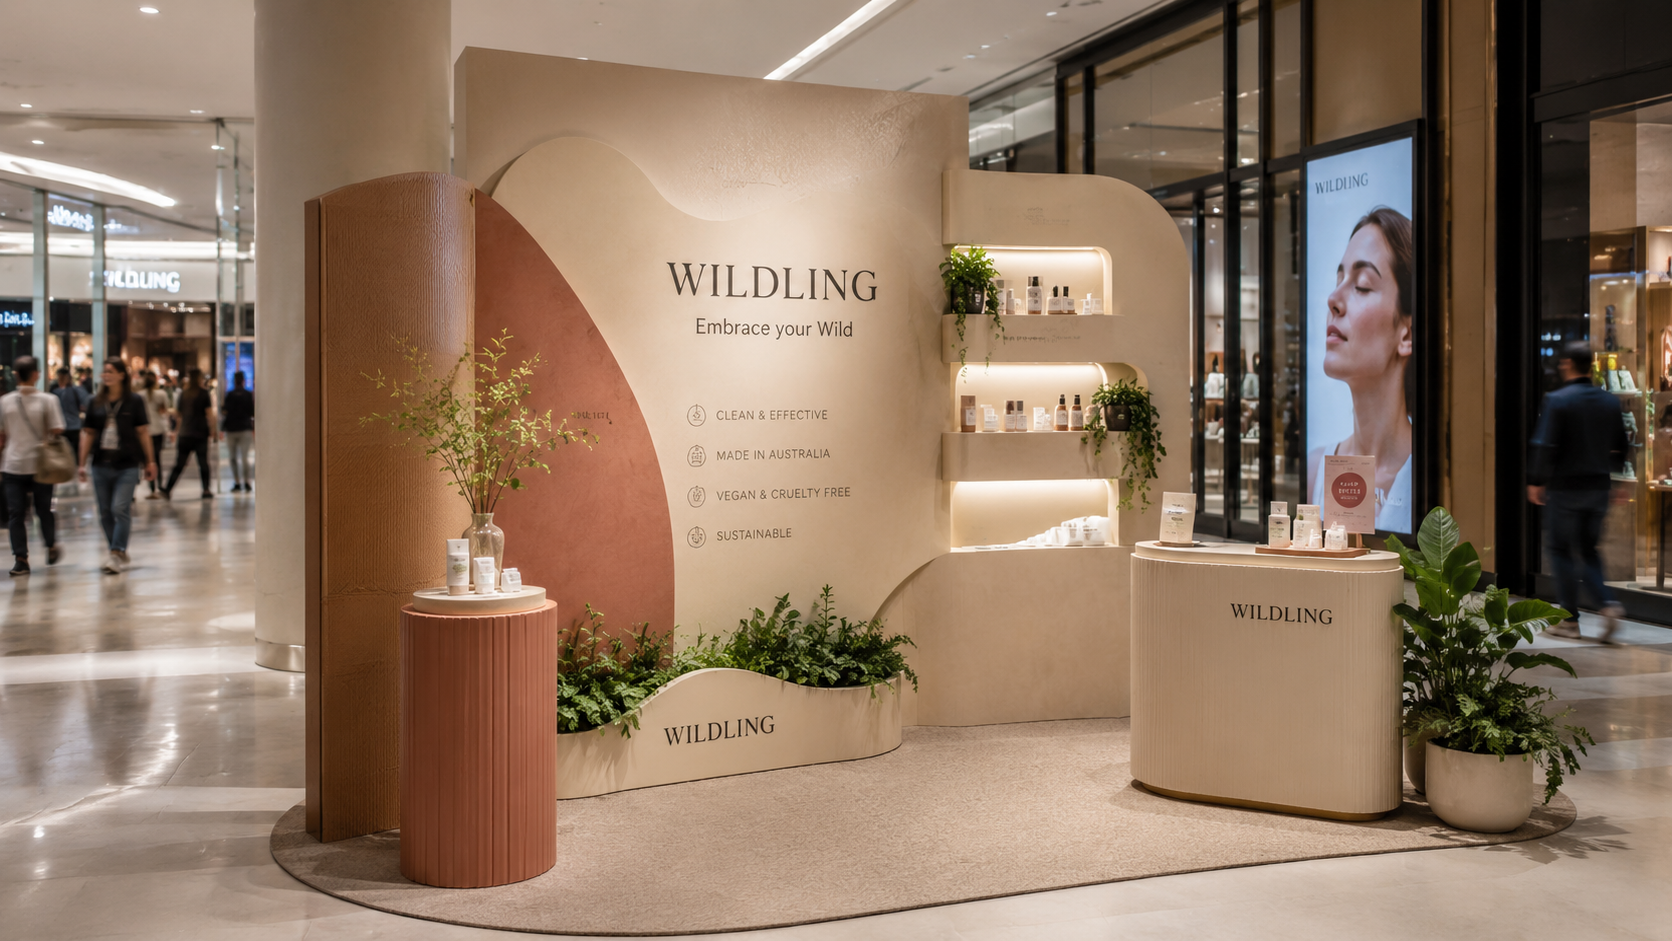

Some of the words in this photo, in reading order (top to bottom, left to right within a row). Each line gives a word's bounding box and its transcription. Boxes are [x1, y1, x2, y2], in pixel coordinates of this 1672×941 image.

[666, 261, 878, 302] WILDLING
[695, 317, 770, 336] Embrace
[775, 323, 812, 340] your
[817, 320, 853, 337] Wild
[716, 410, 755, 421] CLEAN
[758, 410, 766, 421] &
[769, 409, 828, 421] EFFECTIVE
[716, 450, 750, 461] MADE
[753, 449, 765, 460] IN
[768, 448, 831, 460] AUSTRALIA
[716, 490, 756, 501] VEGAN
[759, 489, 767, 500] &
[770, 488, 821, 500] CRUELTY
[824, 486, 851, 498] FREE
[716, 527, 792, 542] SUSTAINABLE
[1230, 602, 1333, 625] WILDLING
[663, 715, 775, 747] WILDLING
